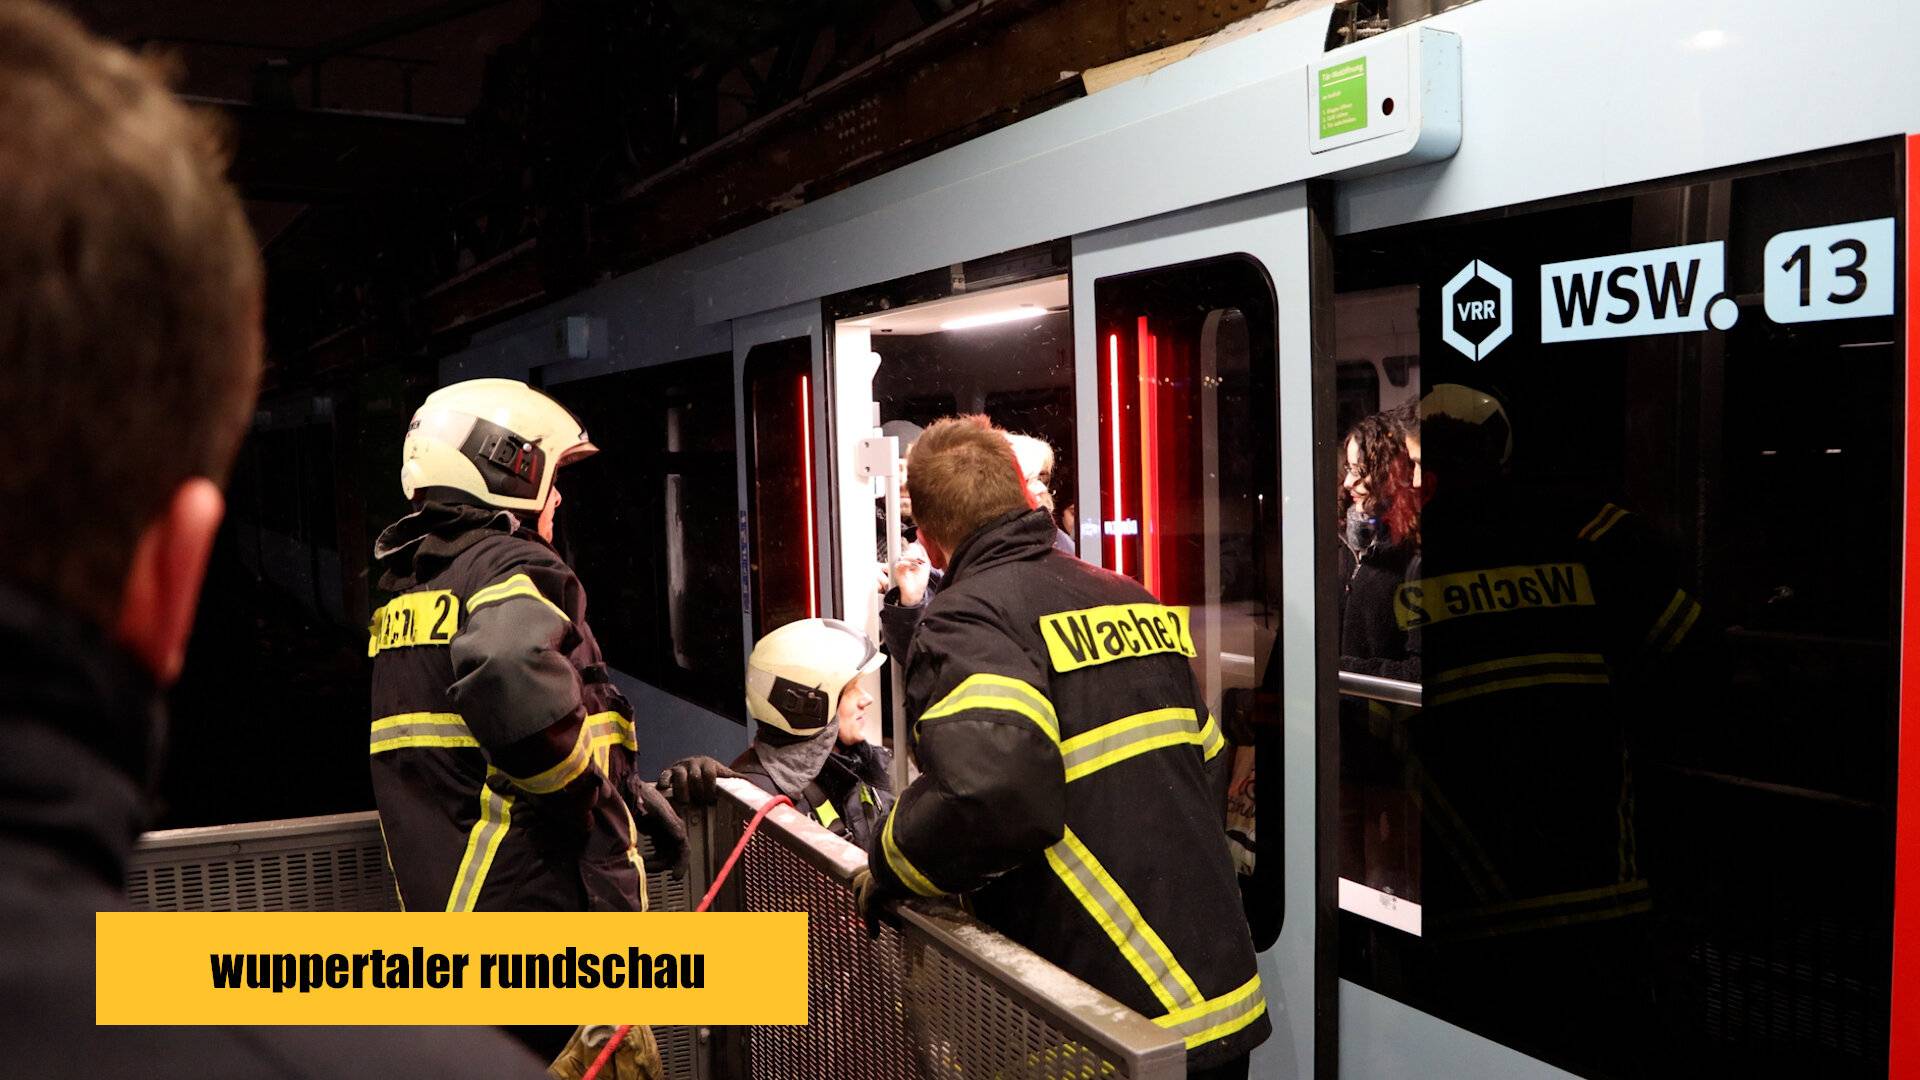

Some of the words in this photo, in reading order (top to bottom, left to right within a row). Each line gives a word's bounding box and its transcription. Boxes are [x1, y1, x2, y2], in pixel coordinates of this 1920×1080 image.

[1780, 238, 1867, 307] 13
[1457, 299, 1496, 322] VRR
[430, 594, 452, 640] 2
[1050, 609, 1175, 663] Wache
